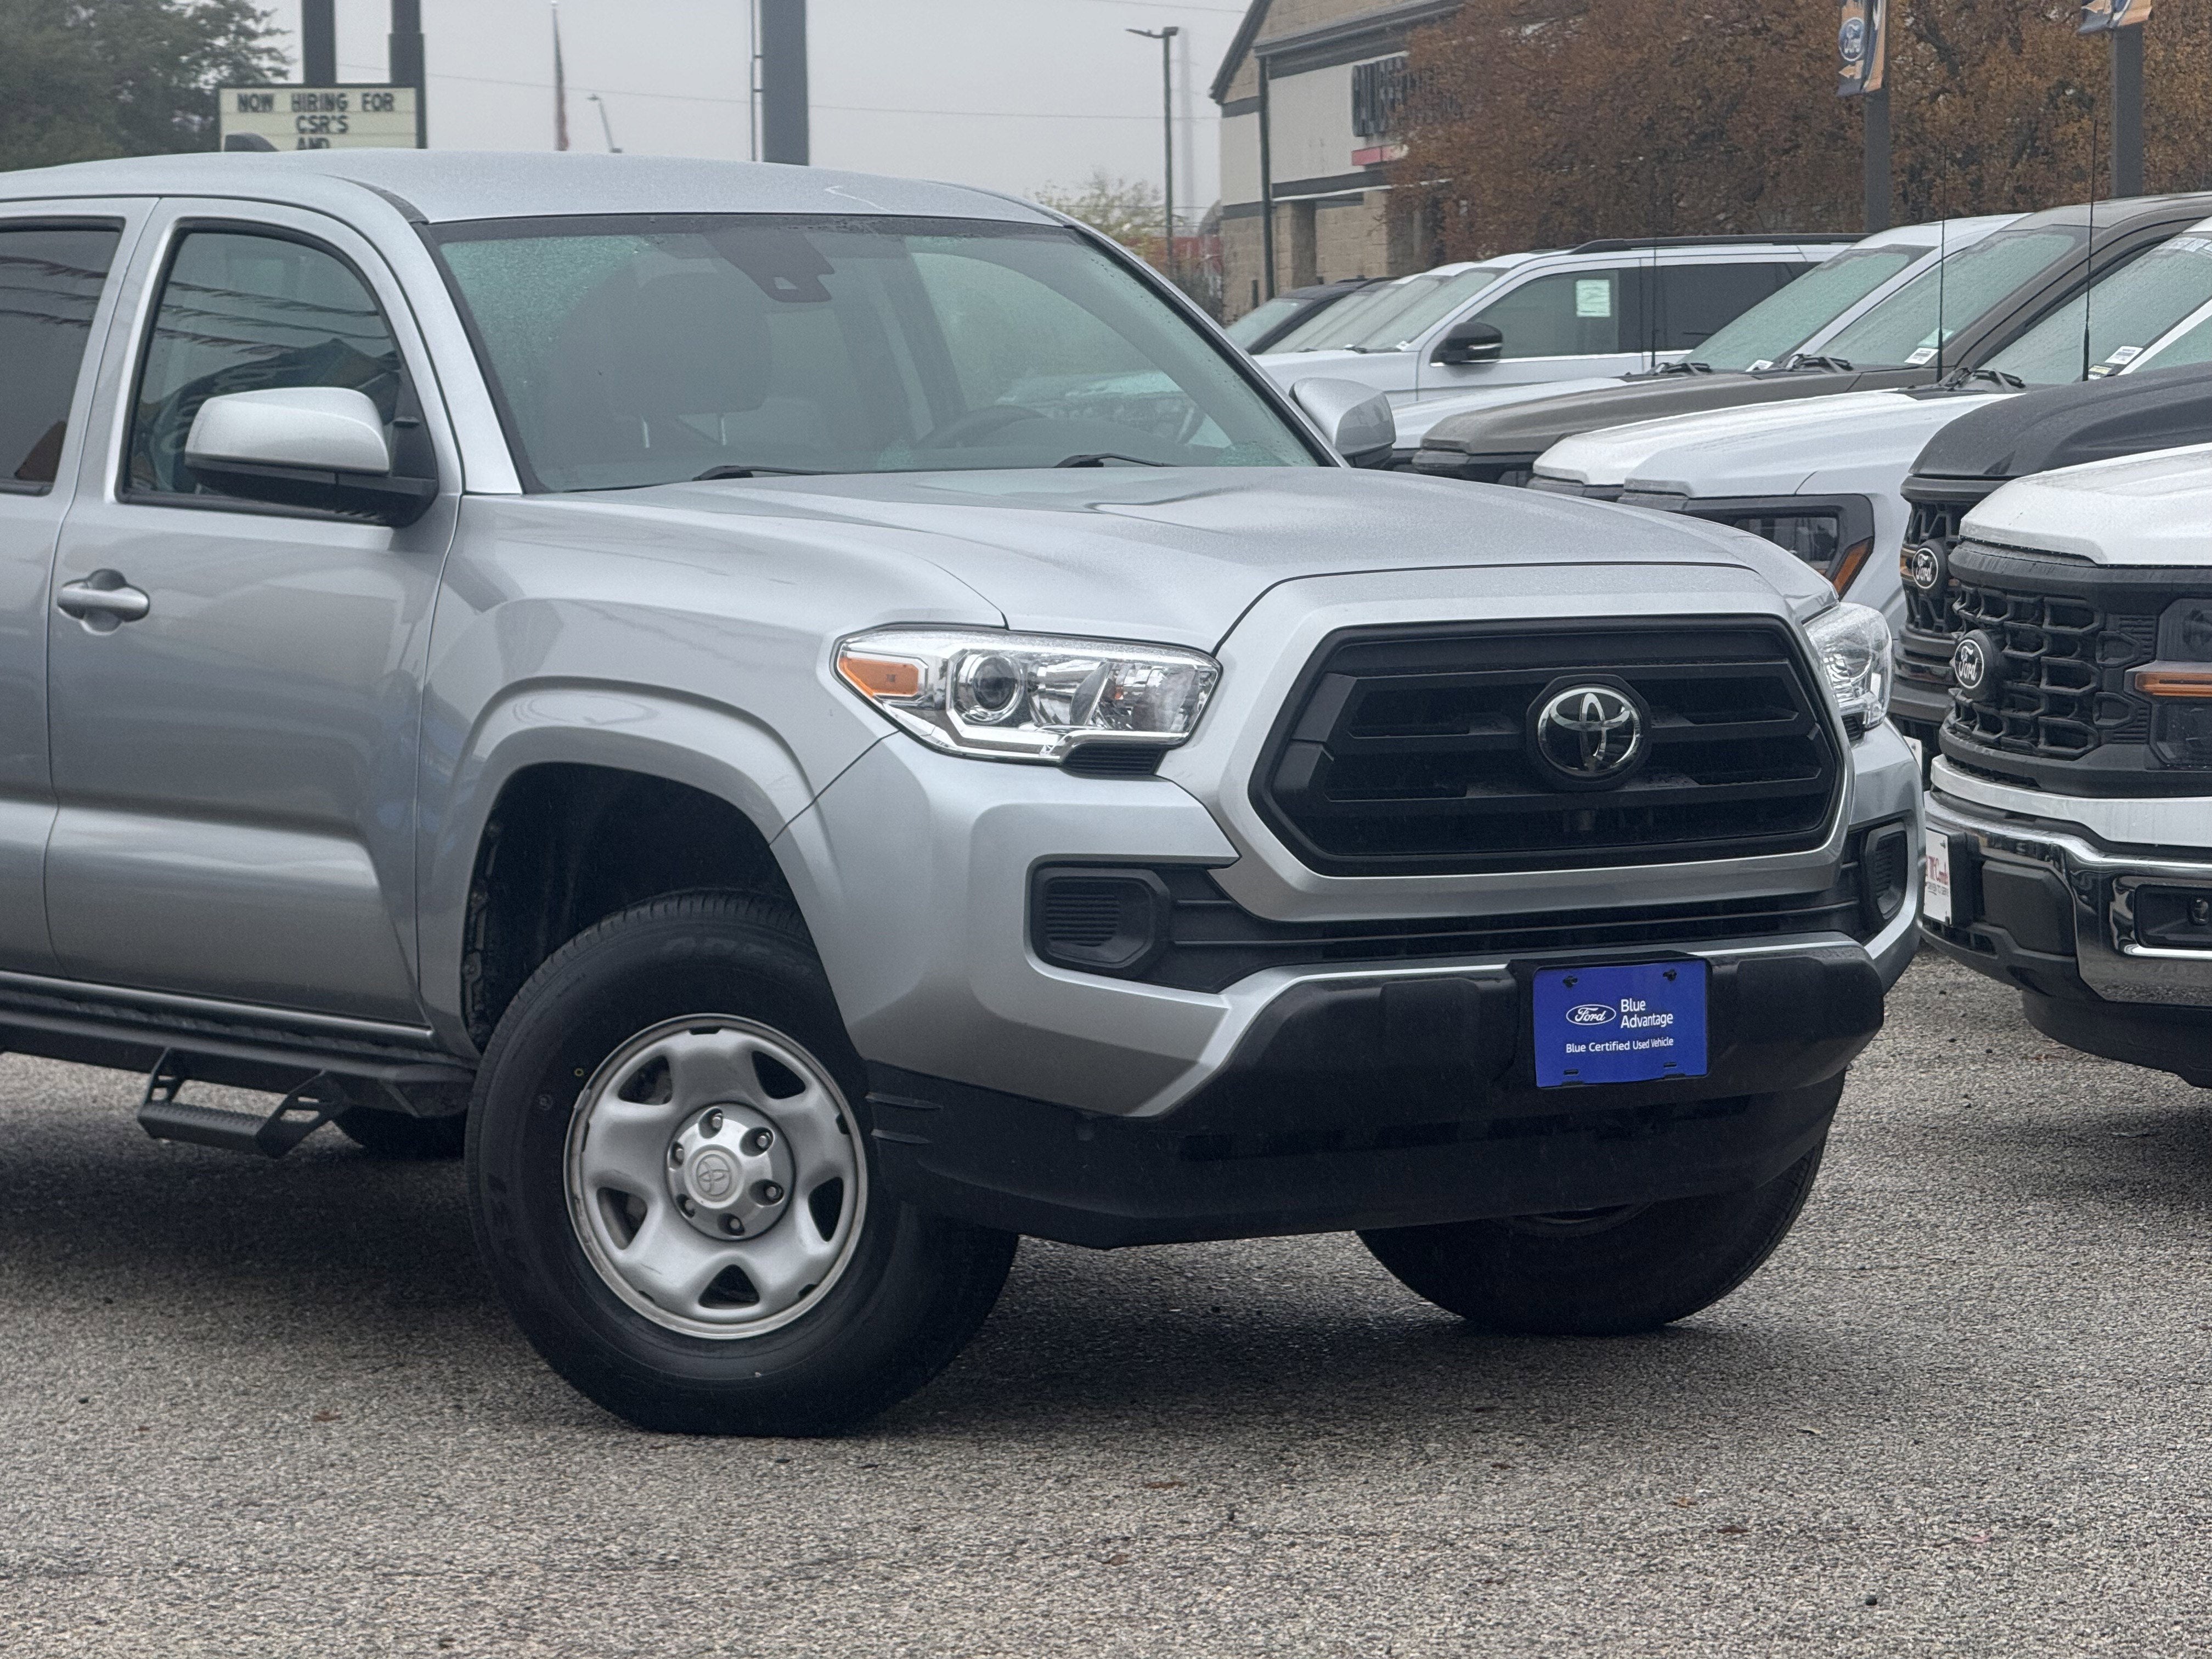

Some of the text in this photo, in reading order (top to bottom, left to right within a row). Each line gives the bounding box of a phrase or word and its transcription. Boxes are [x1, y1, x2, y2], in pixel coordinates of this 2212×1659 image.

[237, 92, 395, 112] NOW HIRING FOR
[296, 115, 349, 134] CSR'S
[296, 137, 330, 150] AND
[1915, 553, 1933, 582] Ford
[1959, 645, 1978, 681] Ford
[1621, 998, 1646, 1012] Blue
[1575, 1007, 1606, 1022] Ford
[1620, 1012, 1674, 1029] Advantage
[1566, 1036, 1674, 1053] Blue Certified Used Vehicle
